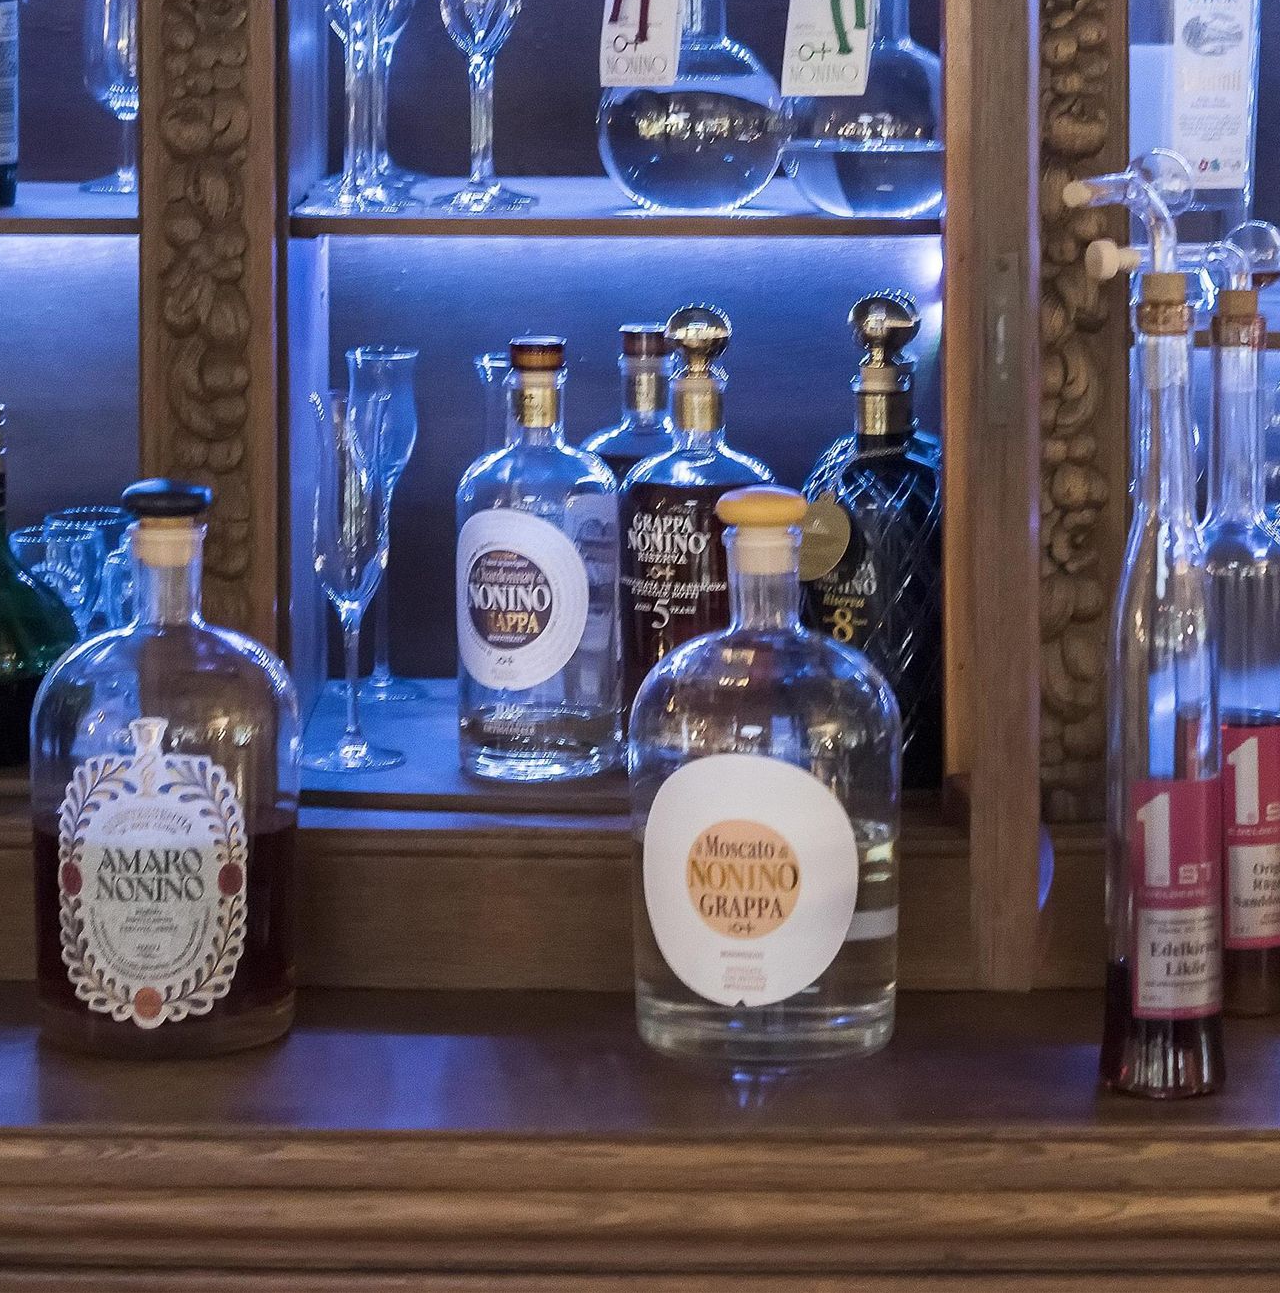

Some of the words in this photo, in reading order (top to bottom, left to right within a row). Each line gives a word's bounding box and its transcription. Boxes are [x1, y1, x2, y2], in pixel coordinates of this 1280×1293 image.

[632, 511, 697, 534] GRAPPA
[627, 527, 712, 555] NONINO
[470, 583, 551, 612] NONINO
[651, 599, 670, 629] 5
[832, 608, 854, 643] 8
[705, 834, 775, 859] Moscato
[95, 847, 203, 877] AMARO
[94, 875, 205, 903] NONINO
[689, 860, 799, 893] NONINO
[699, 894, 783, 919] GRAPPA
[1165, 958, 1206, 977] Likör
